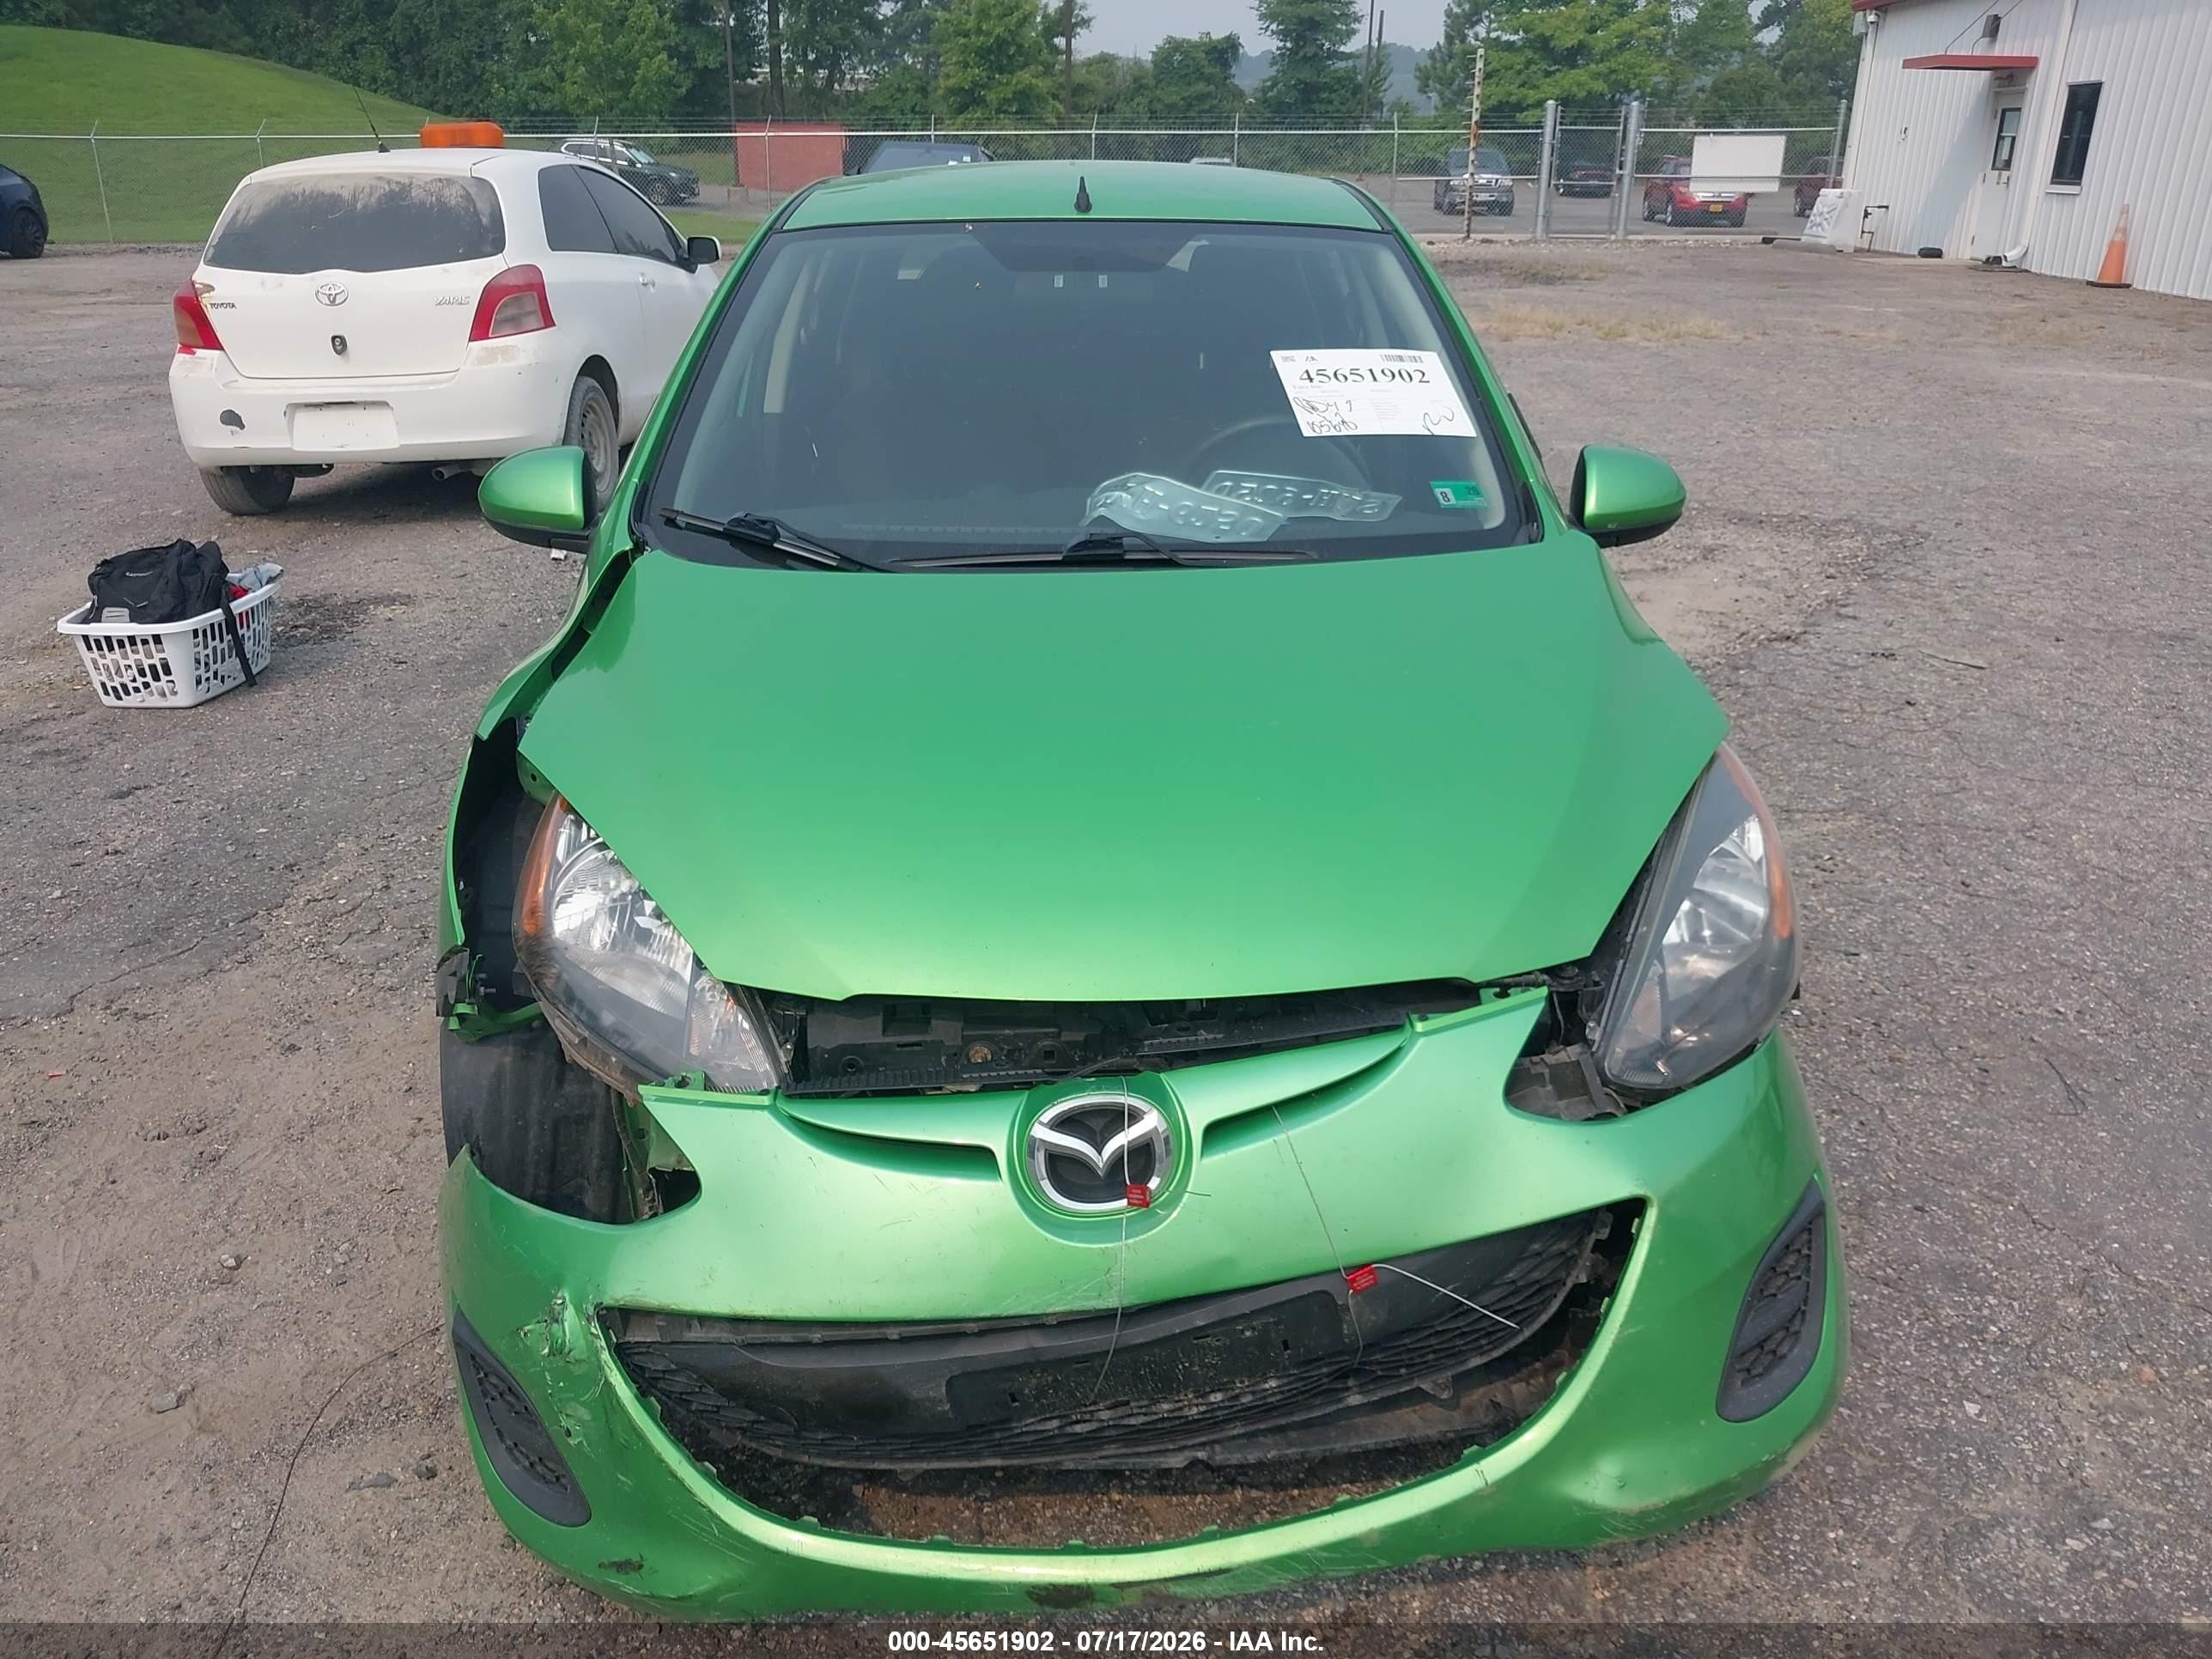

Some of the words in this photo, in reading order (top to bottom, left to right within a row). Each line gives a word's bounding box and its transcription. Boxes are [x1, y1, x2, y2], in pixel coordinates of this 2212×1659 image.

[434, 295, 471, 307] YARIS
[1299, 368, 1431, 384] 45651902
[1440, 491, 1450, 502] 8
